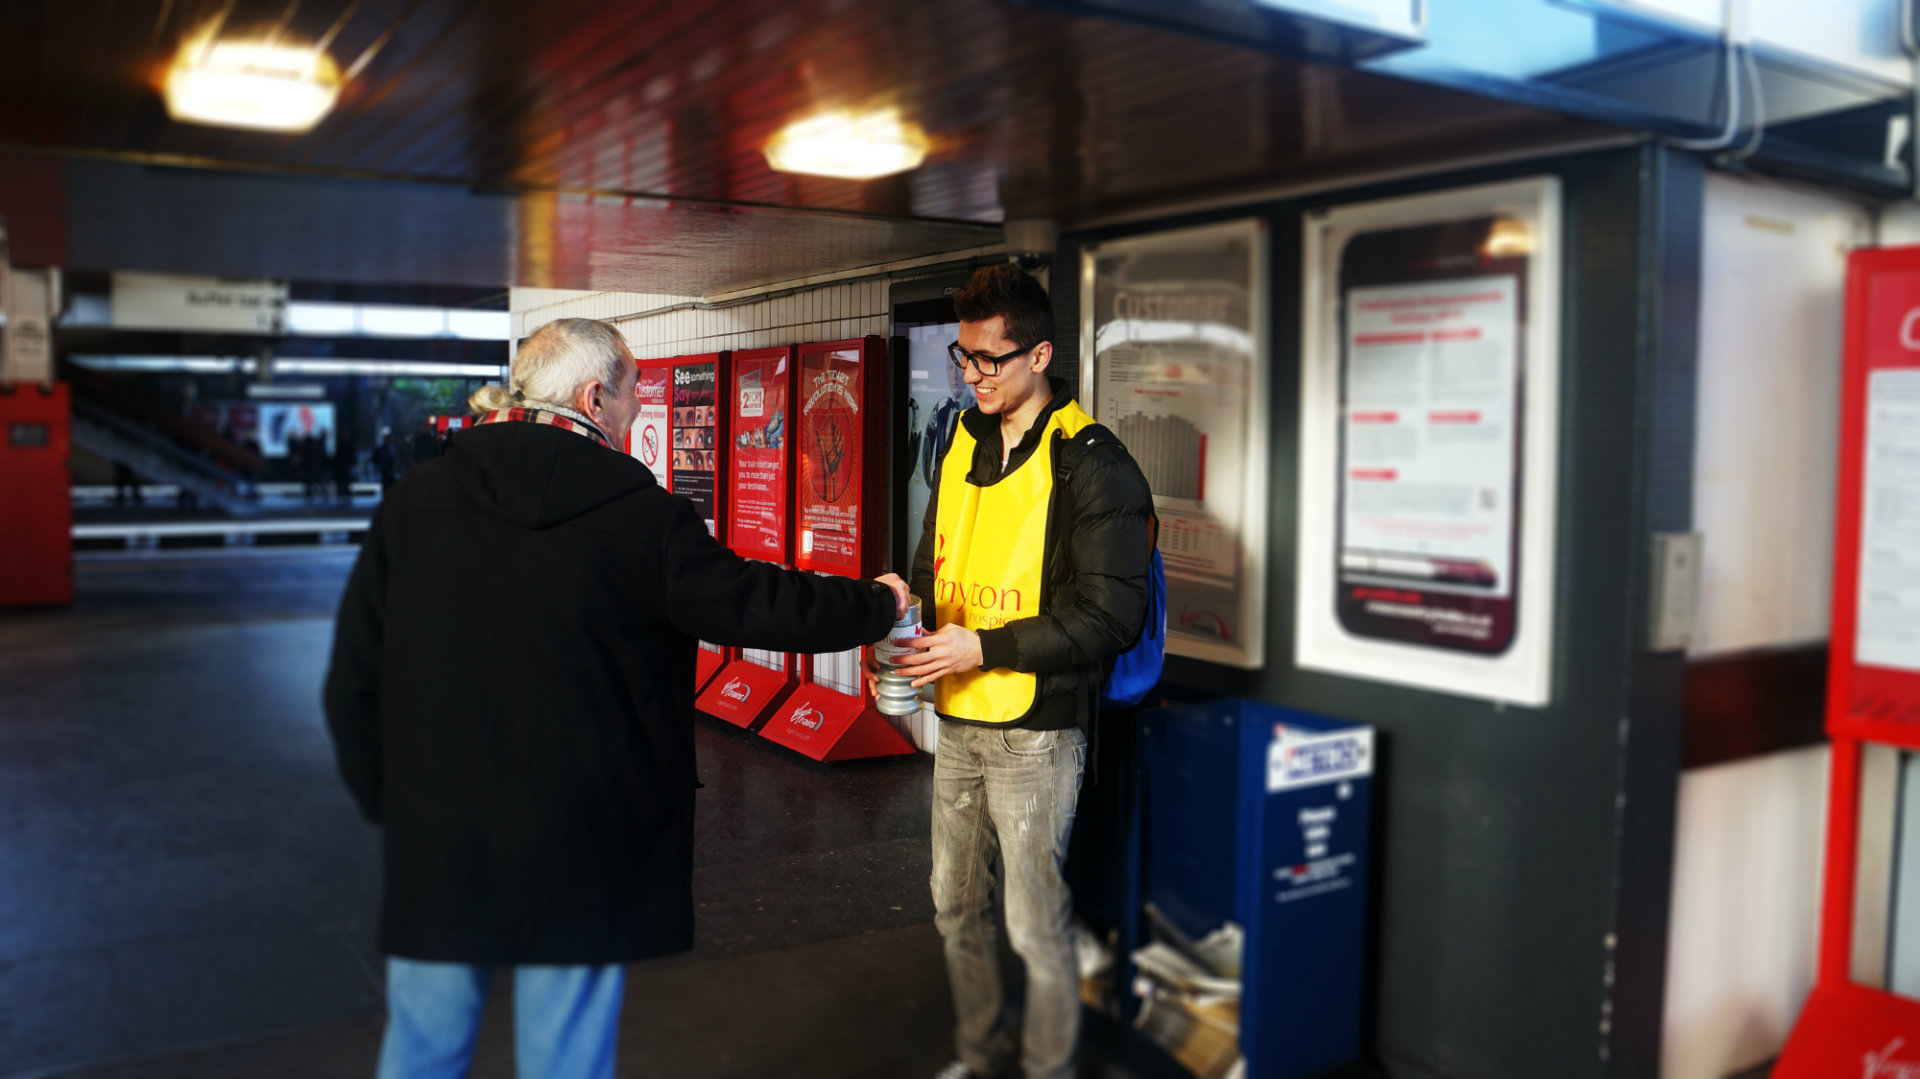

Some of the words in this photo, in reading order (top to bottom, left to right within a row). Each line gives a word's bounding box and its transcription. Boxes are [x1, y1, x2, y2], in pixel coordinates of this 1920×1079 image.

[674, 368, 691, 385] See
[691, 371, 715, 383] something
[634, 384, 666, 398] Customer
[674, 386, 691, 405] Say
[743, 391, 749, 408] 2
[936, 576, 1021, 612] myton
